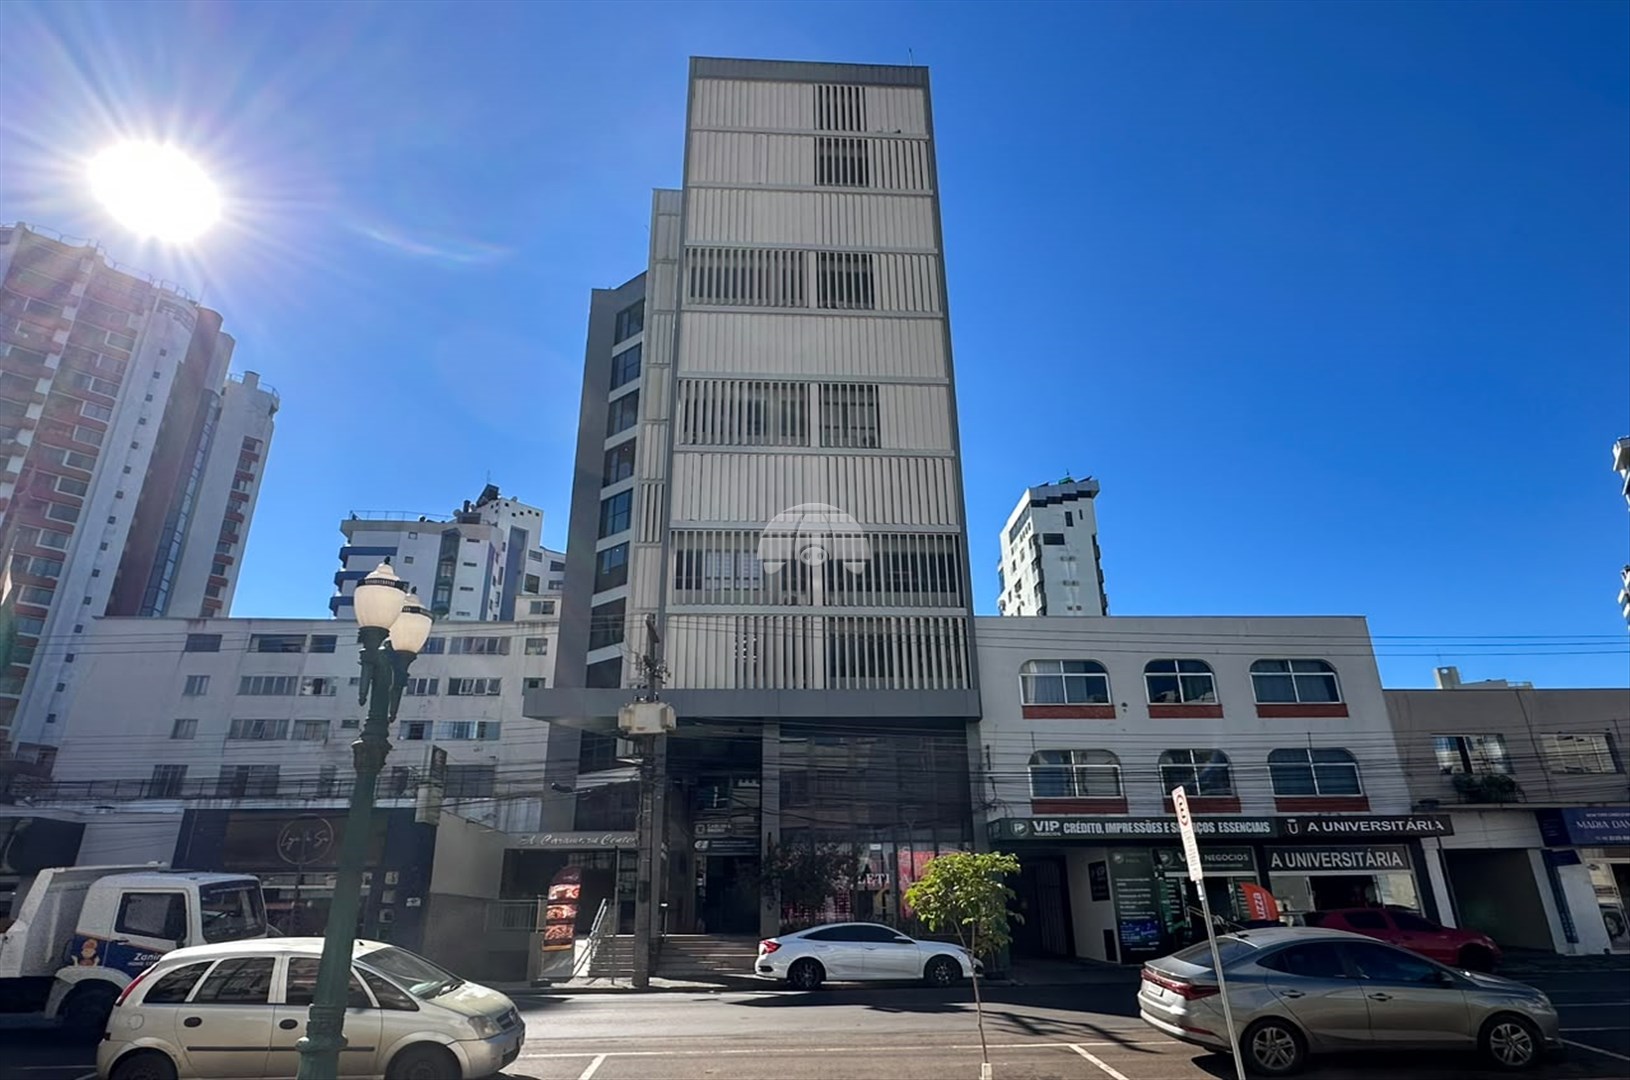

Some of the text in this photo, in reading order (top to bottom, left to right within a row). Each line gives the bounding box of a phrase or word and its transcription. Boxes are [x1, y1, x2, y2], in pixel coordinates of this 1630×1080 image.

[1032, 820, 1060, 832] VIP
[1063, 820, 1104, 834] CRÉDITO,
[1105, 820, 1162, 834] IMPRESSÕES
[1163, 822, 1170, 833] E
[1307, 818, 1444, 832] A UNIVERSITÁRIA
[1271, 848, 1403, 868] A UNIVERSITÁRIA
